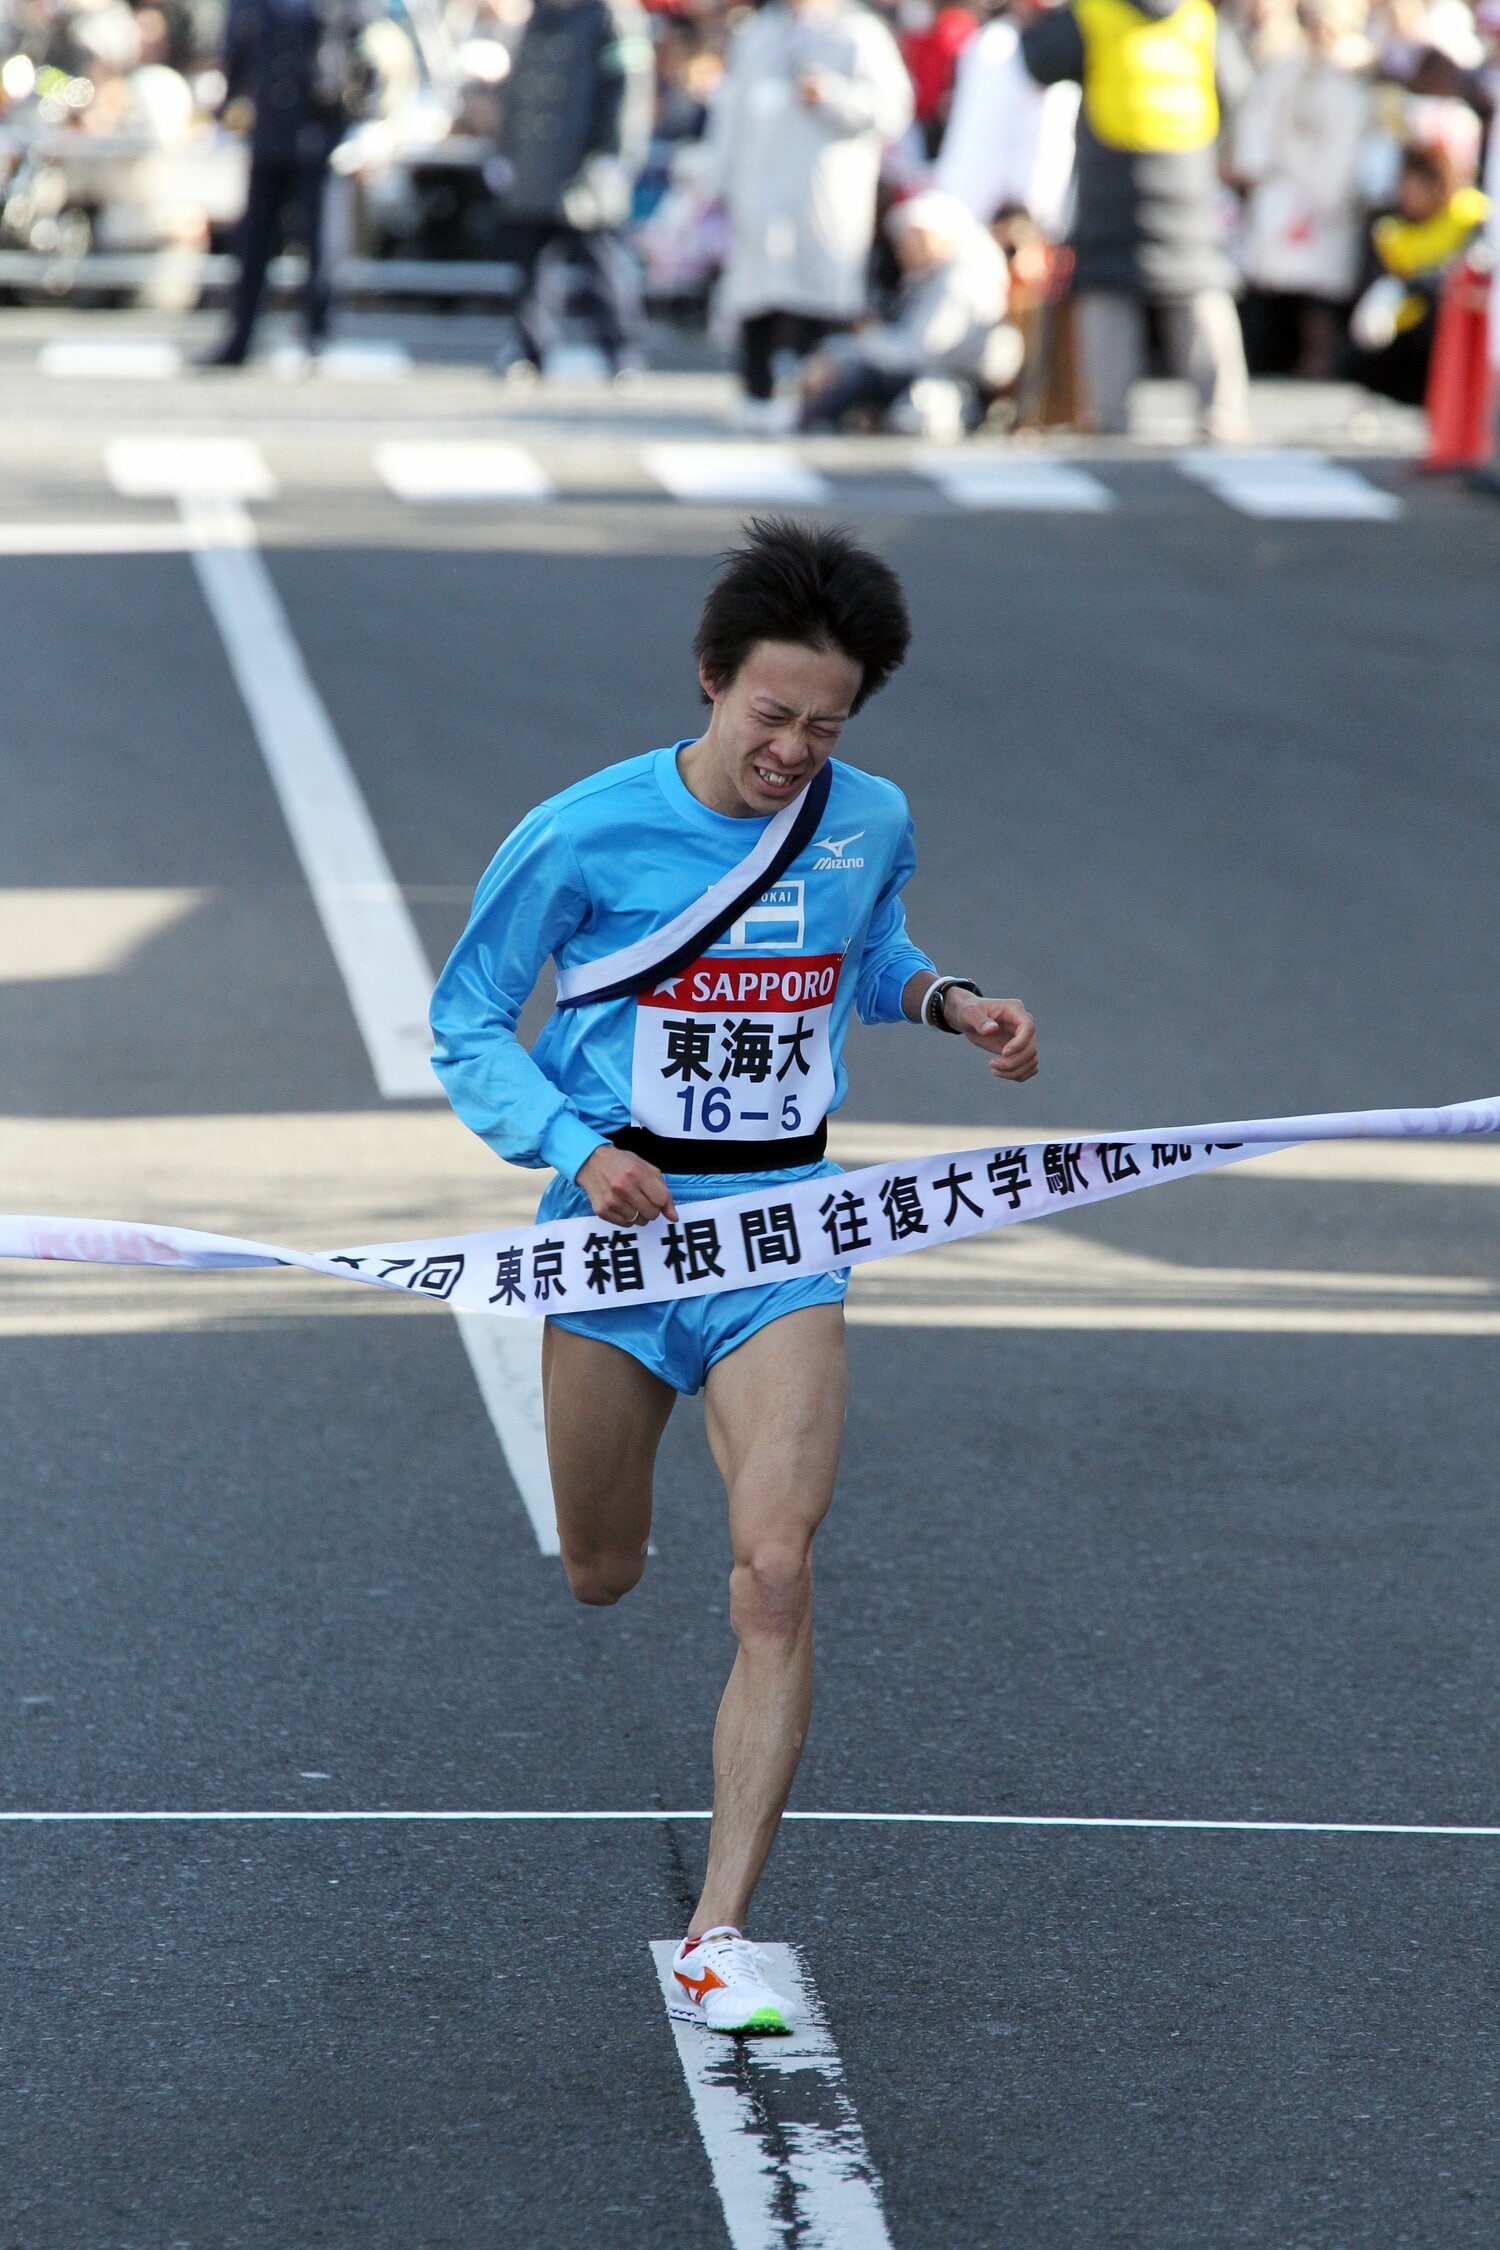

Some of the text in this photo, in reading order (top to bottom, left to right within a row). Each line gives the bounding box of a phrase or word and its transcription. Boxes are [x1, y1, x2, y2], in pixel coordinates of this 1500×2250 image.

[760, 891, 792, 903] OKAI
[691, 966, 835, 1002] SAPPORO
[660, 1016, 815, 1083] 東海大
